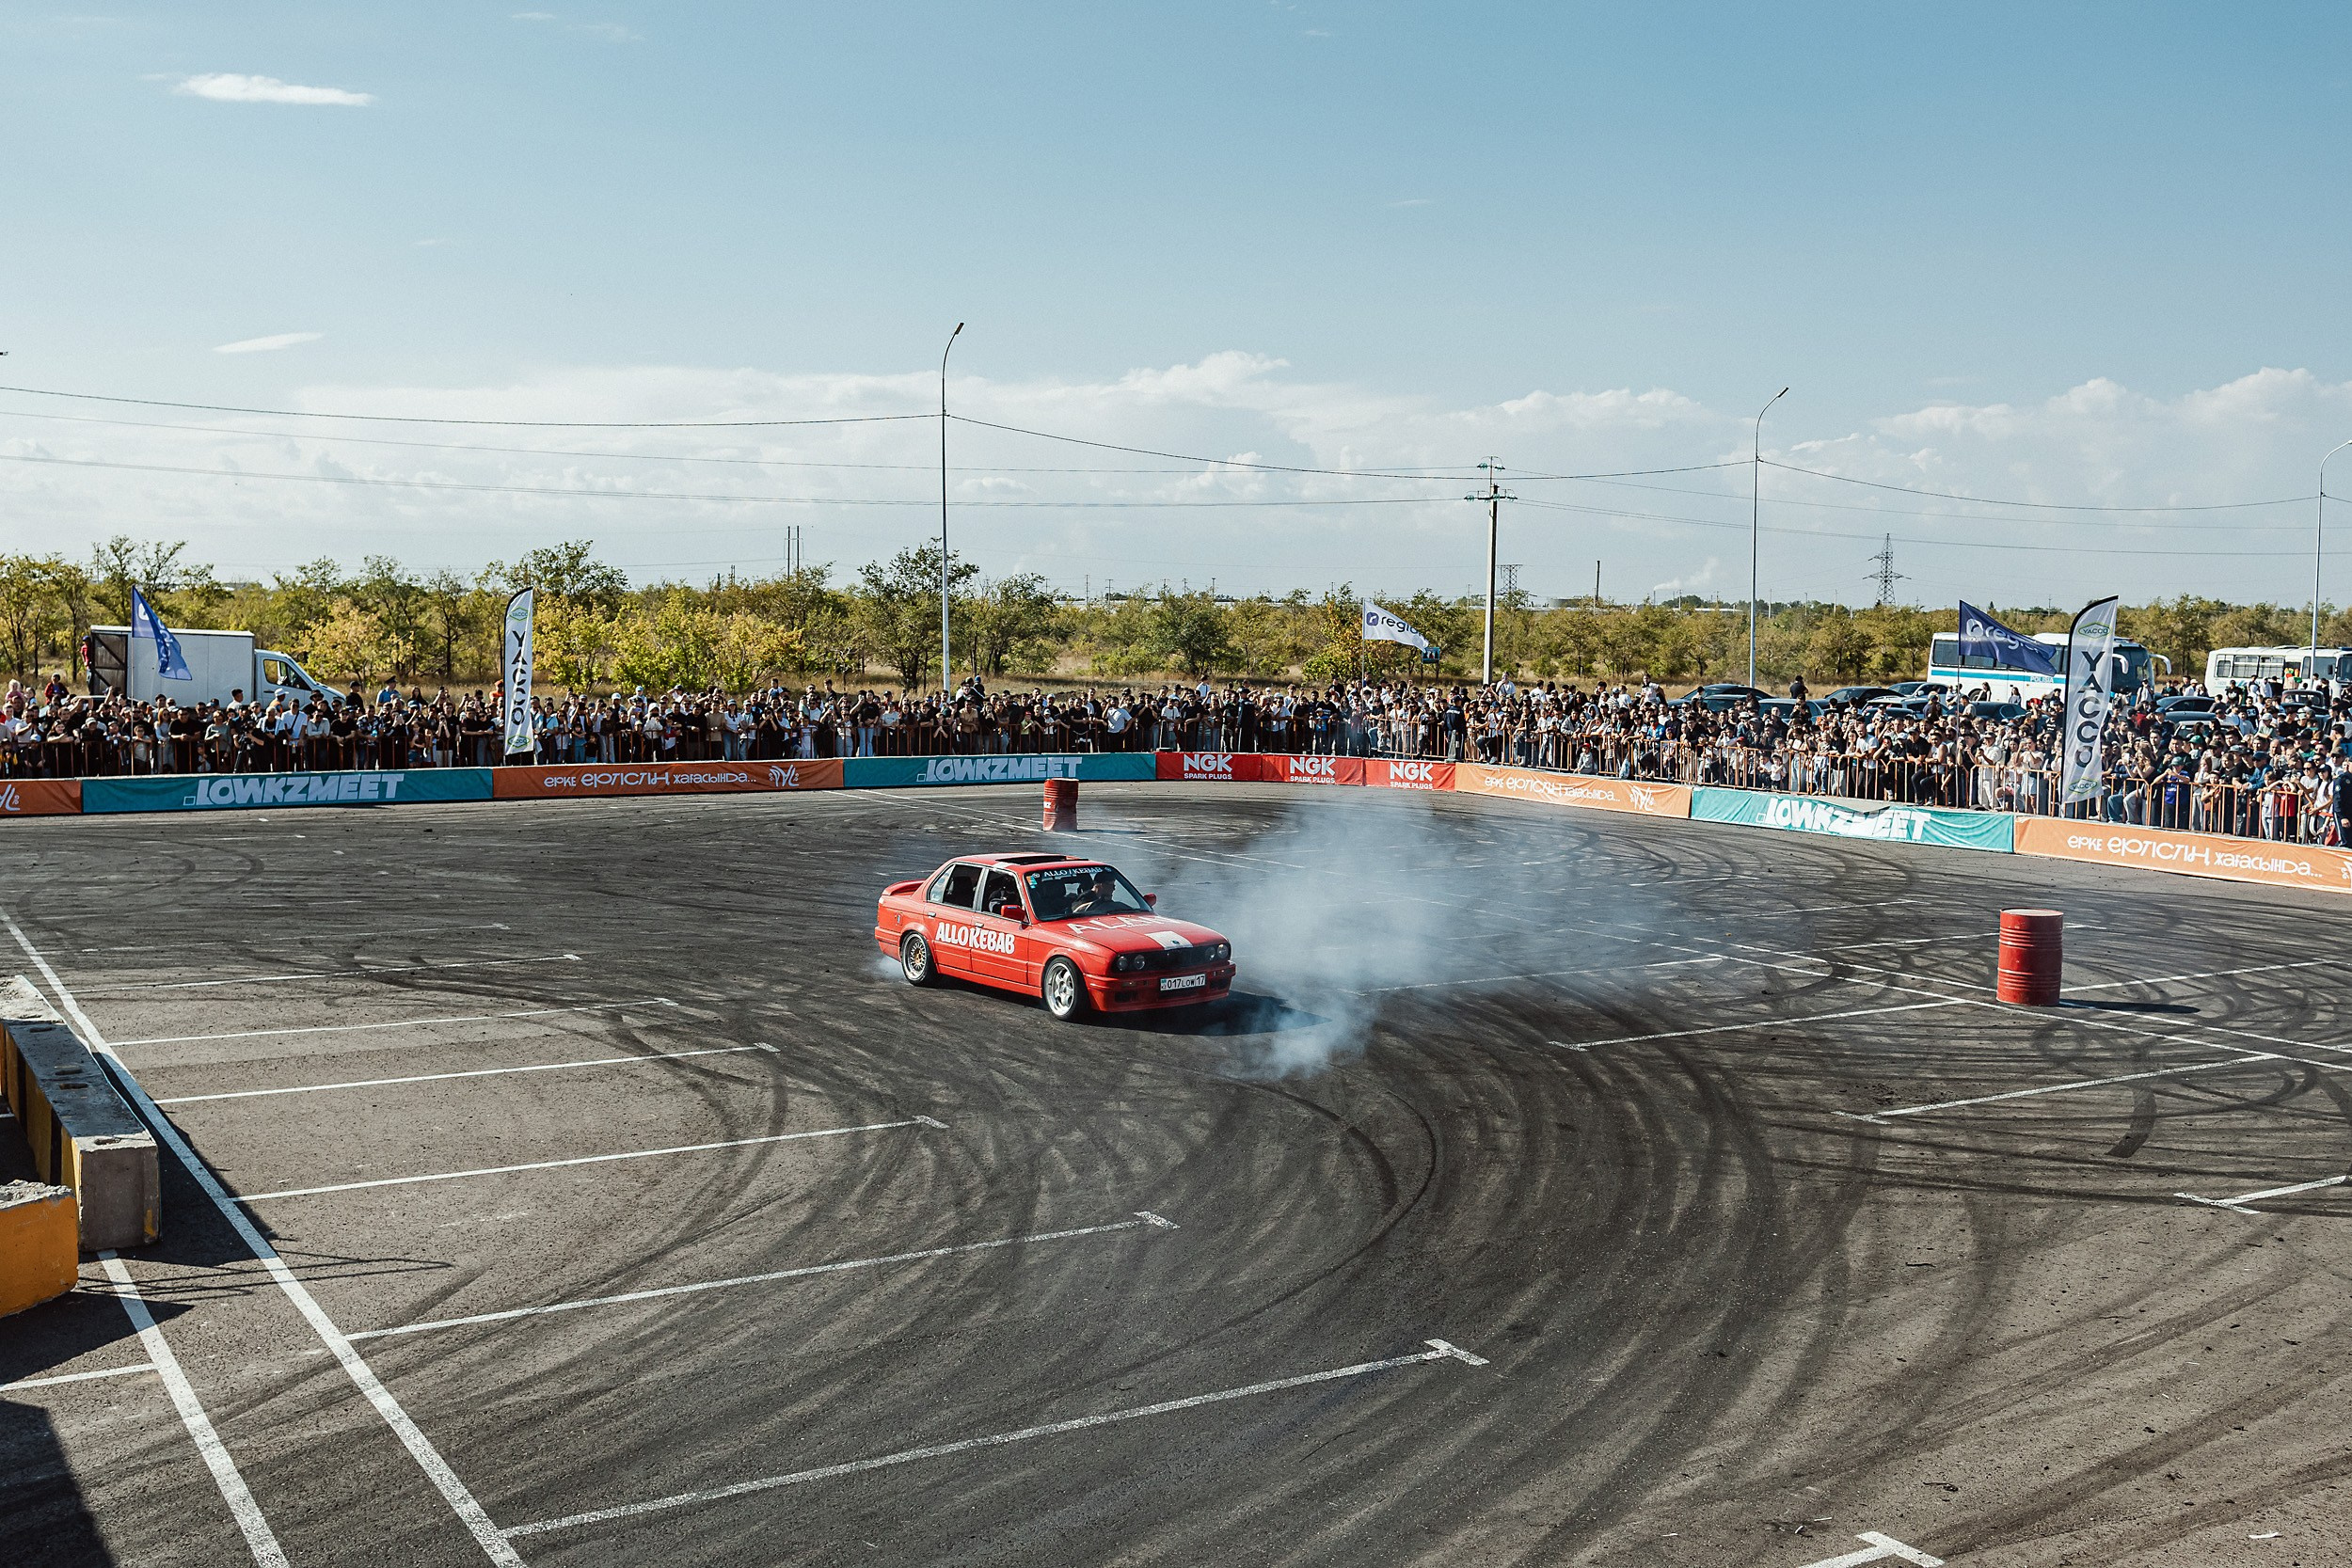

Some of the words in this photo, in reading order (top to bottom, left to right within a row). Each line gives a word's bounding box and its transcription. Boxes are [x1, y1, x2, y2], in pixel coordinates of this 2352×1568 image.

[511, 630, 528, 725] YACCO
[2074, 651, 2106, 768] YACCO
[926, 756, 1083, 782] LOWKZMEET
[1184, 753, 1233, 772] NGK
[1290, 756, 1336, 776] NGK
[1390, 762, 1434, 782] NGK
[196, 773, 405, 806] LOWKZMEET
[935, 922, 1015, 954] ALLOKEBAB
